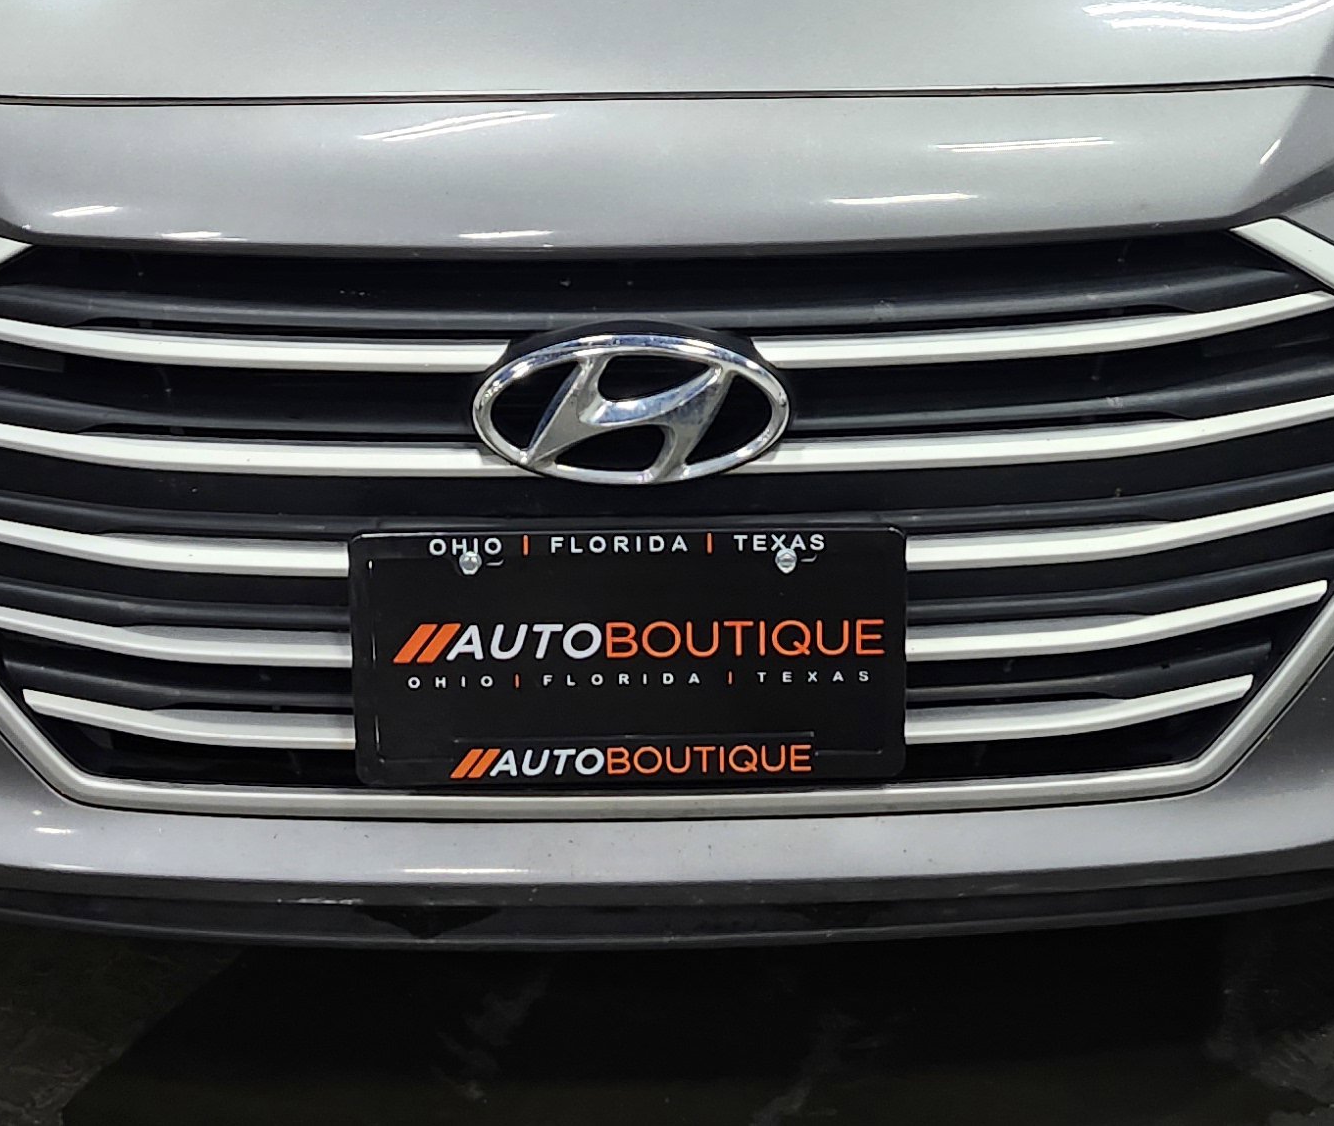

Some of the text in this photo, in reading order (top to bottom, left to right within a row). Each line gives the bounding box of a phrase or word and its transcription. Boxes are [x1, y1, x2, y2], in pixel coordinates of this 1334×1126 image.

[429, 533, 826, 556] OHIO FLORIDA TEXAS
[446, 618, 886, 661] AUTOBOUTIQUE
[407, 670, 870, 689] OHIO FLORIDA TEXAS
[489, 744, 813, 778] AUTOBOUTIQUE
